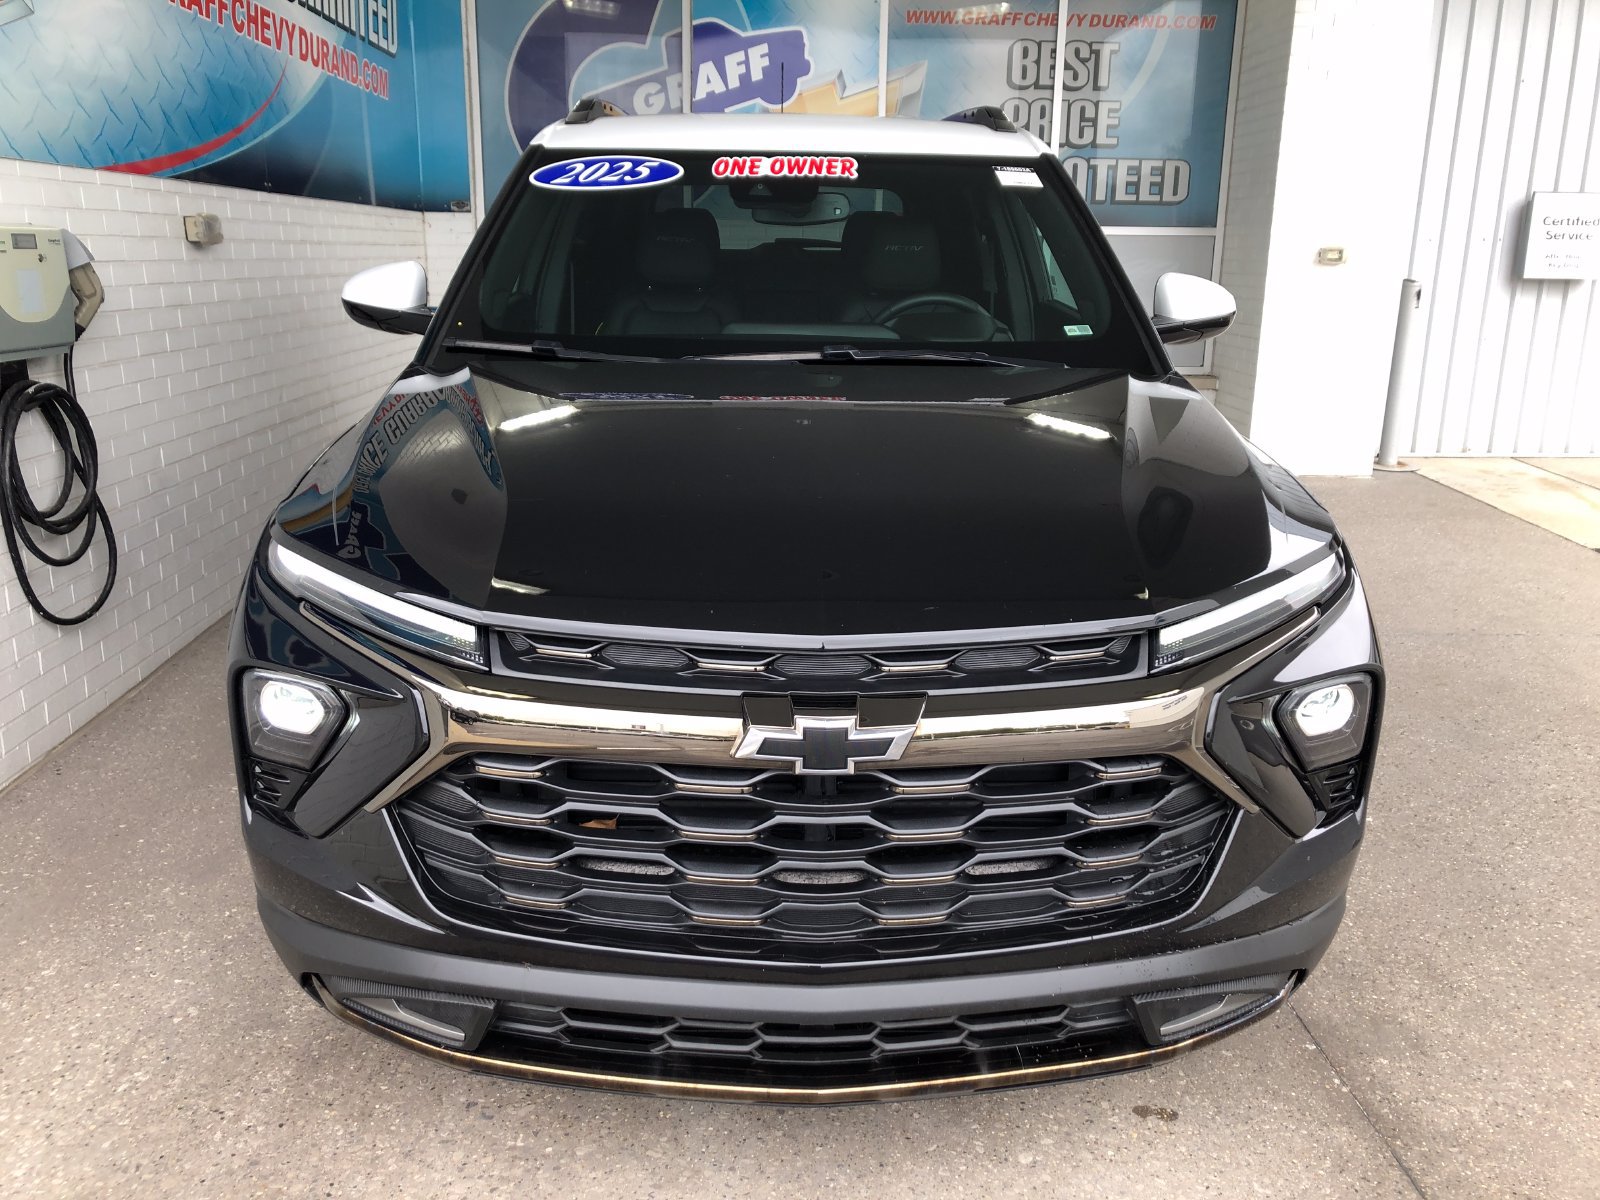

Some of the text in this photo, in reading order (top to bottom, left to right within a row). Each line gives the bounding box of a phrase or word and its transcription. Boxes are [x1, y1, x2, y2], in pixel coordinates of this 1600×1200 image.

[168, 0, 389, 99] FFCHEVYDURAND.COM
[1007, 39, 1121, 91] BEST
[632, 42, 770, 115] GRAFF
[1003, 97, 1122, 148] PRICE
[550, 161, 661, 184] 2025
[713, 157, 858, 178] ONE OWNER
[1061, 156, 1191, 206] NTEED
[1545, 230, 1593, 241] Service
